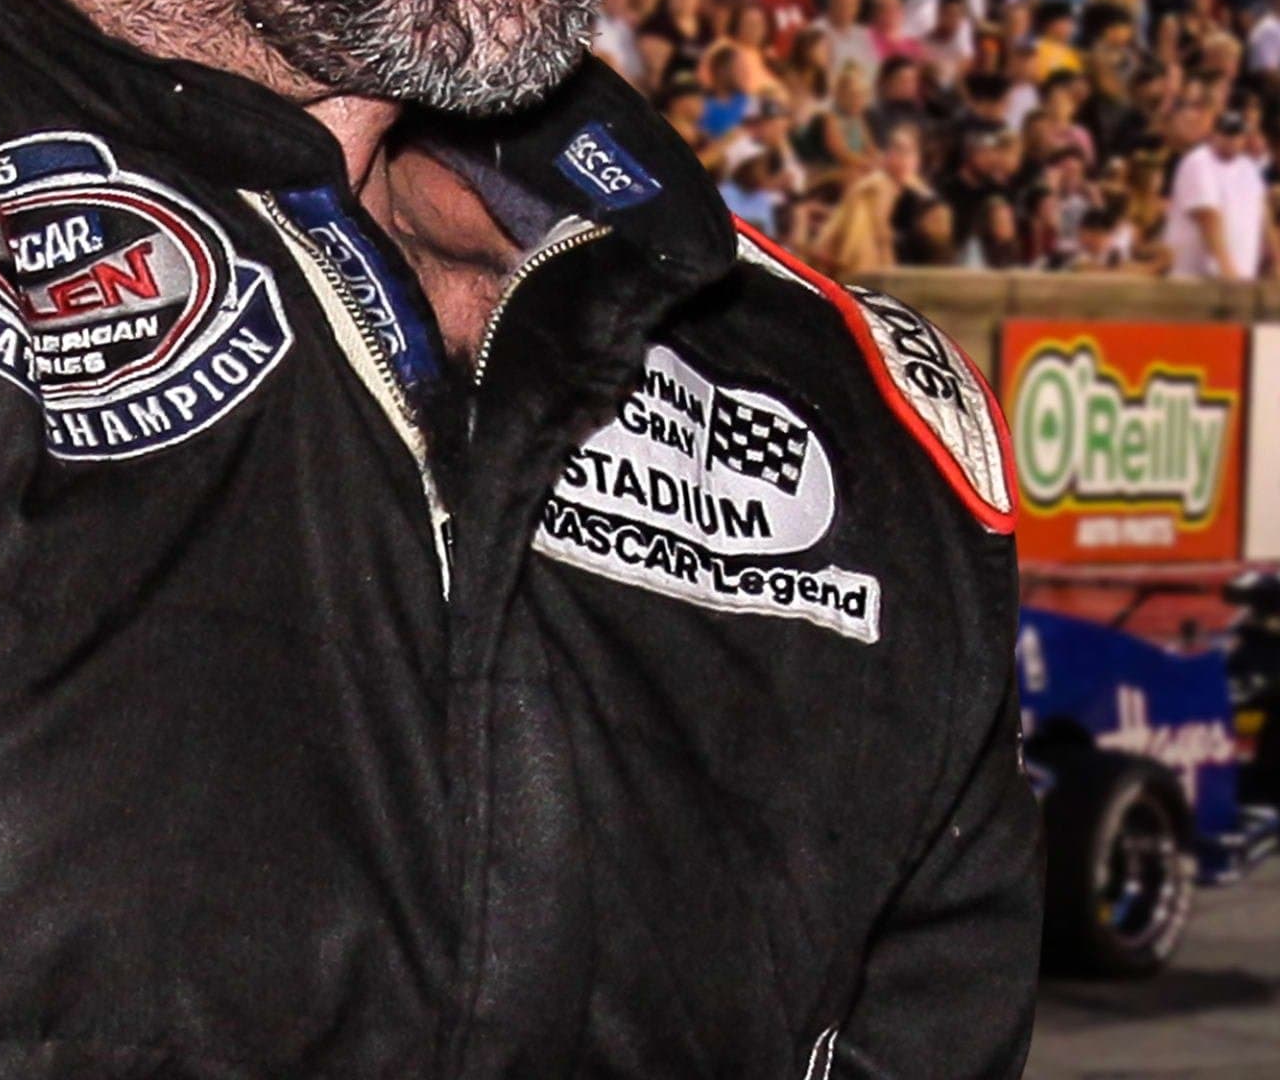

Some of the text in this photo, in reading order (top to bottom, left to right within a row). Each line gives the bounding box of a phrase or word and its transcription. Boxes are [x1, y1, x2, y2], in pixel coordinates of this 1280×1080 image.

[21, 241, 160, 322] LEN
[619, 397, 695, 459] GRAY
[1020, 360, 1224, 505] O'Reilly
[564, 447, 772, 538] STADIUM
[713, 560, 867, 618] Legend
